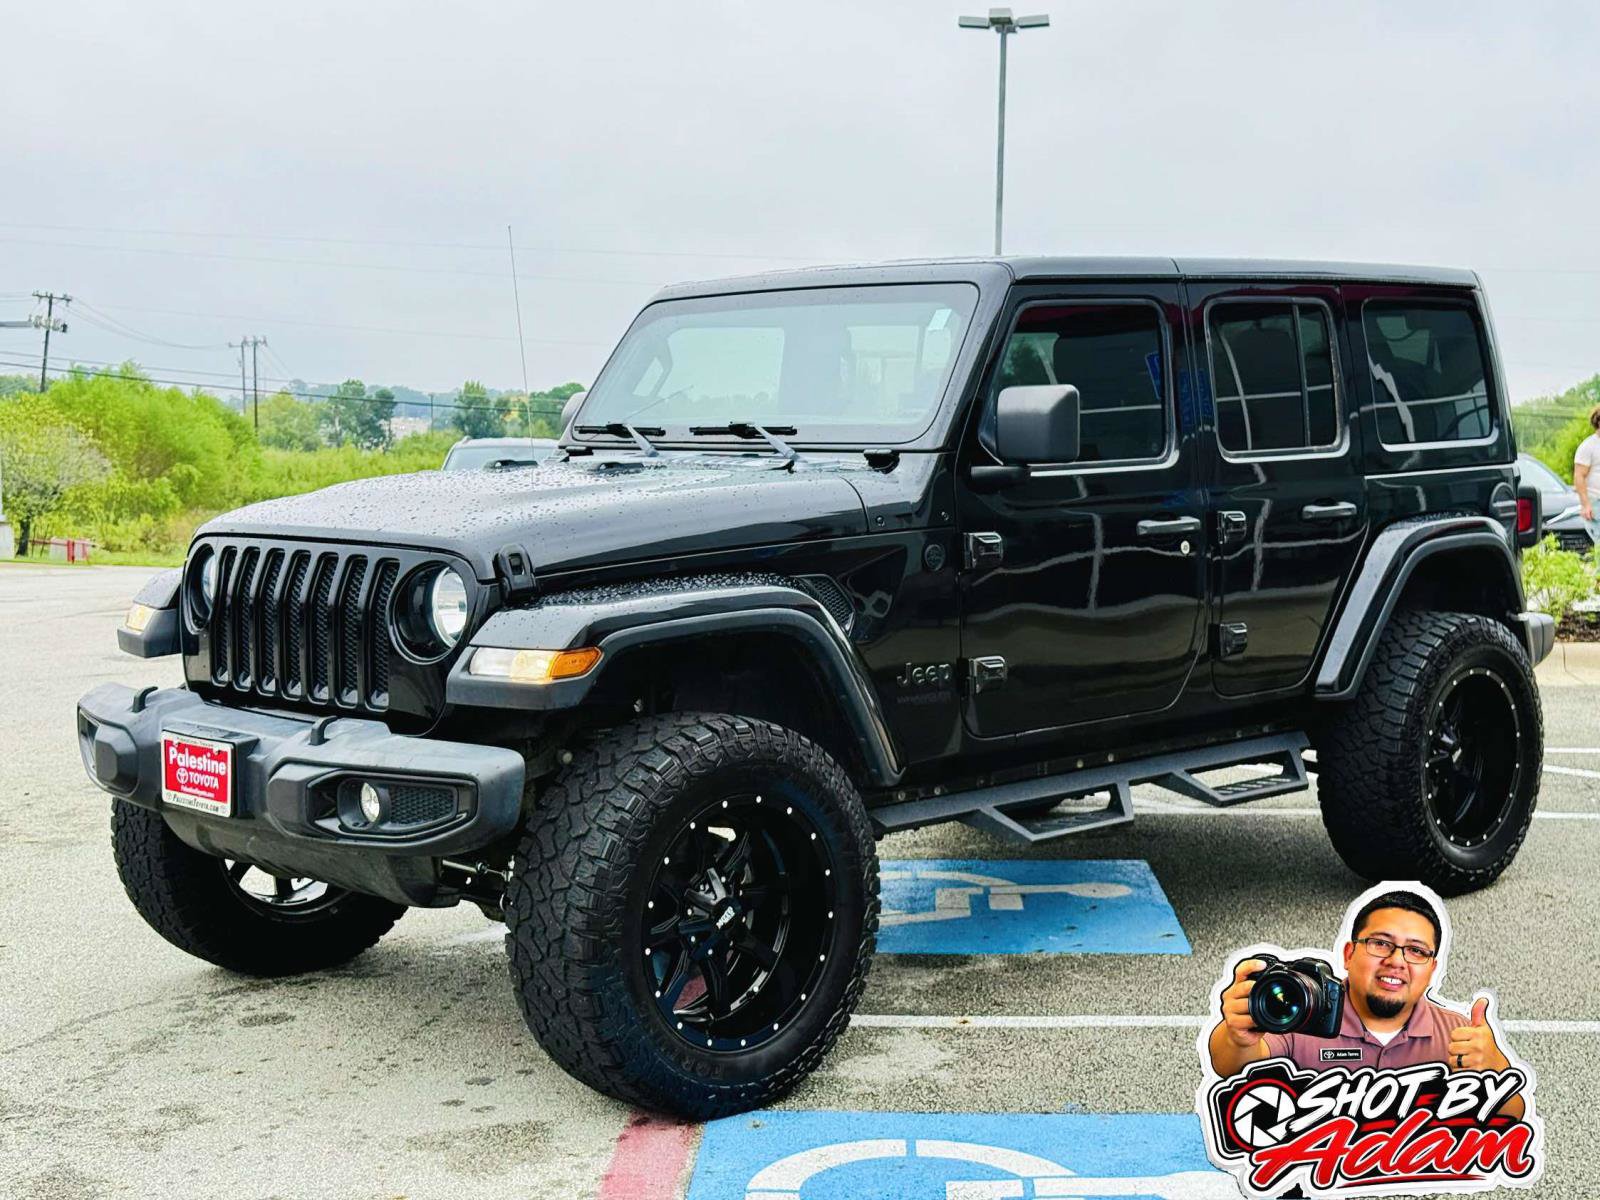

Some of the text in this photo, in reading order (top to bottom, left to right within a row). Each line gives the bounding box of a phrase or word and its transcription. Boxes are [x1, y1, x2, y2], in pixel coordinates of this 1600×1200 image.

[896, 662, 952, 687] Jeep
[169, 746, 226, 775] Palestine
[189, 771, 219, 789] TOYOTA
